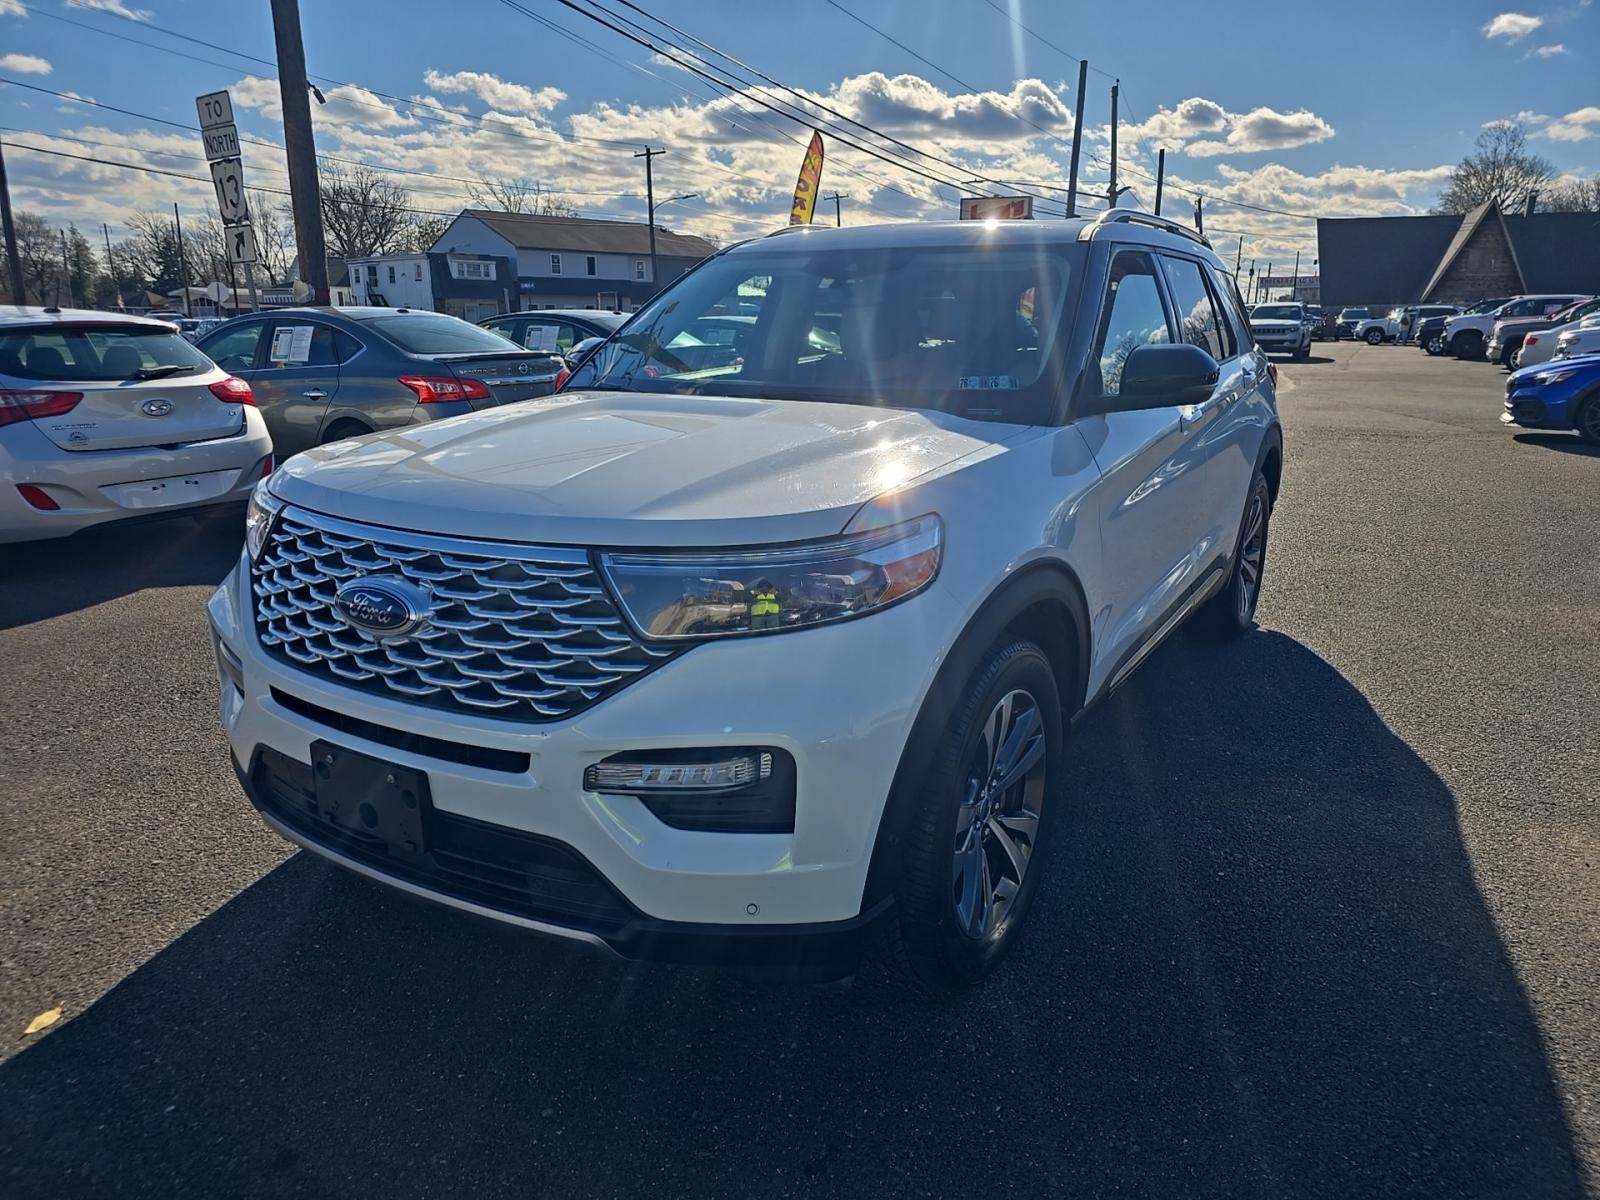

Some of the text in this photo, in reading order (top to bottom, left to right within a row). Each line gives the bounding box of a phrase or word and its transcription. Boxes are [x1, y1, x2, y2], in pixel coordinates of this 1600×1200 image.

[205, 100, 222, 119] TO
[204, 132, 237, 155] NORTH
[219, 175, 240, 210] 13
[349, 592, 393, 623] Ford
